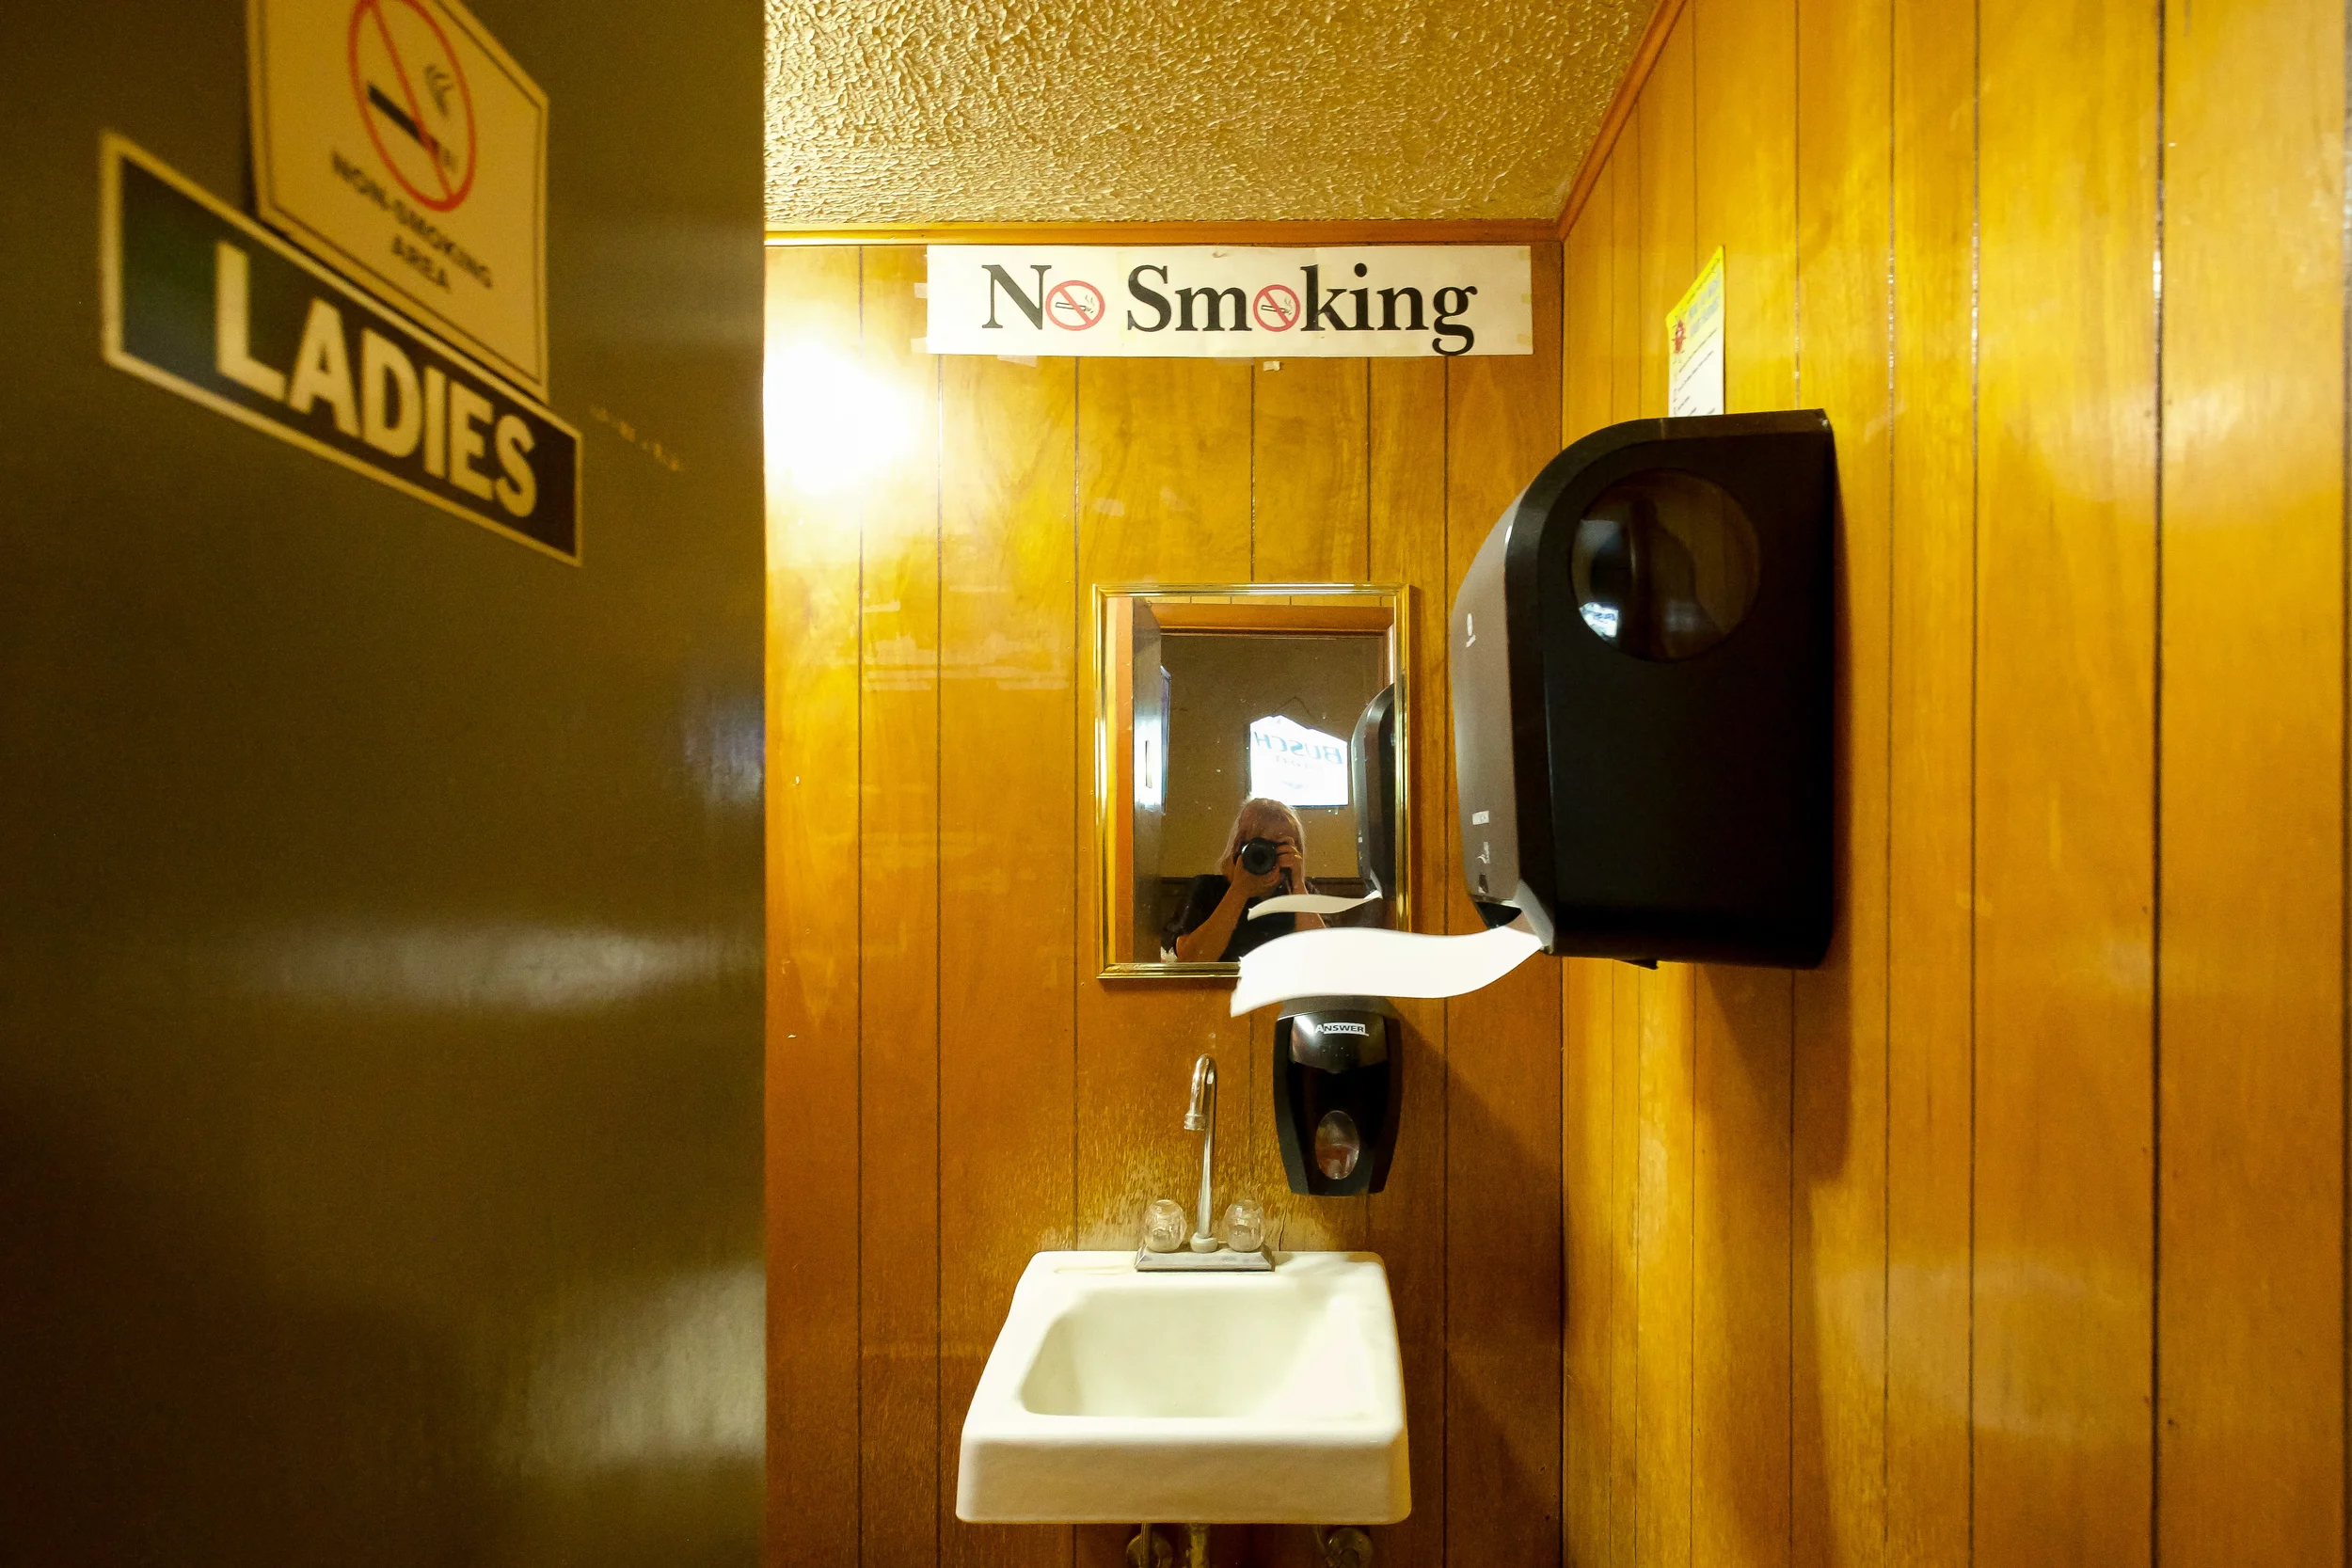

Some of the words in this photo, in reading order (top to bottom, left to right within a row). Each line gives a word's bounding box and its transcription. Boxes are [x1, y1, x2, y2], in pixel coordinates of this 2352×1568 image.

[332, 150, 493, 289] NON-SMOKING
[391, 235, 451, 293] AREA
[215, 241, 536, 518] LADIES
[1315, 1023, 1364, 1033] ANSWER
